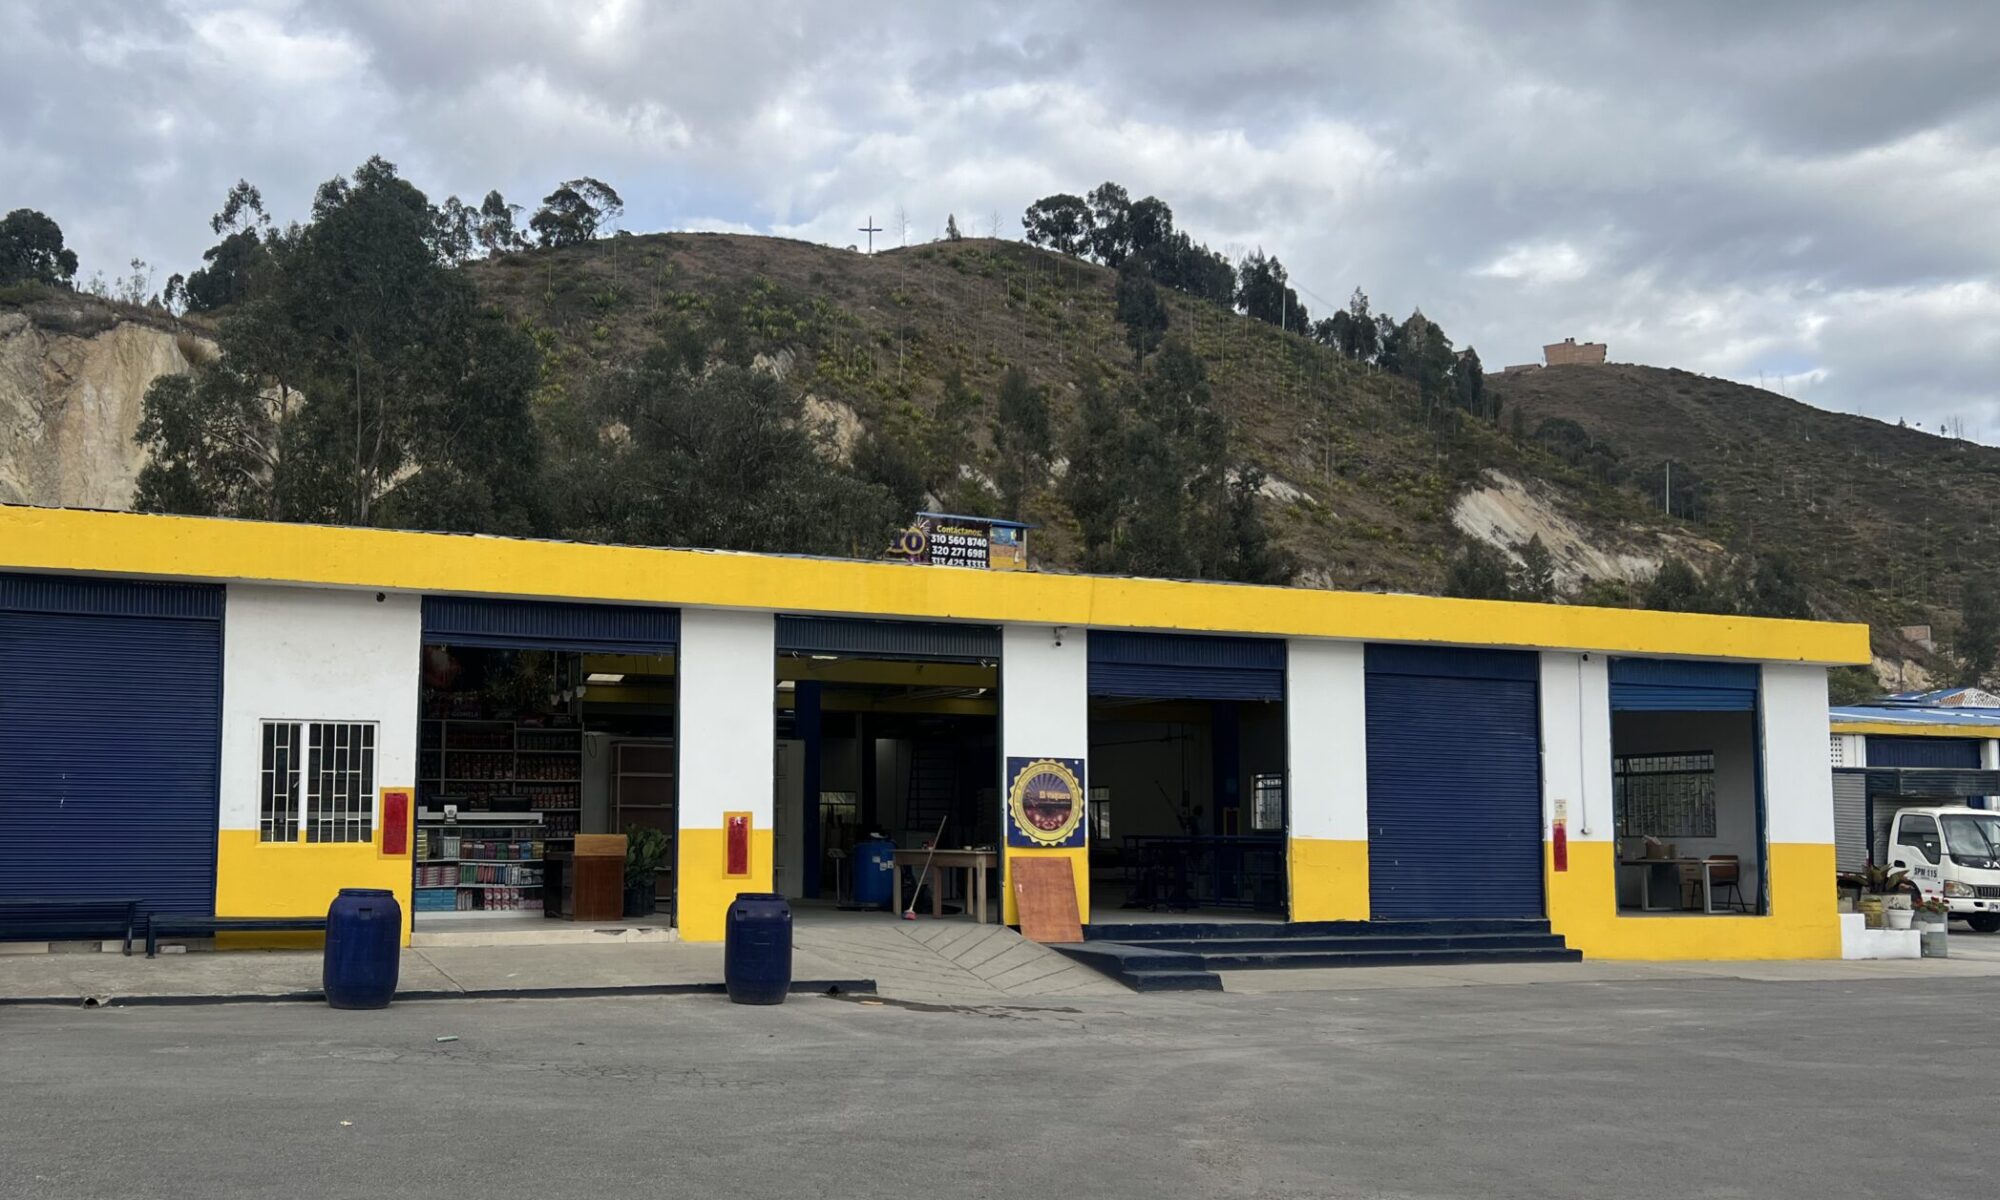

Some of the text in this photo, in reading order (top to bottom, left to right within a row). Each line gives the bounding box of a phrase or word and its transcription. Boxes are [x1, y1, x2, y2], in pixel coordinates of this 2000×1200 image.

[930, 534, 987, 547] 310 560 8740
[931, 545, 986, 558] 320 271 6981
[1927, 869, 1937, 878] 115
